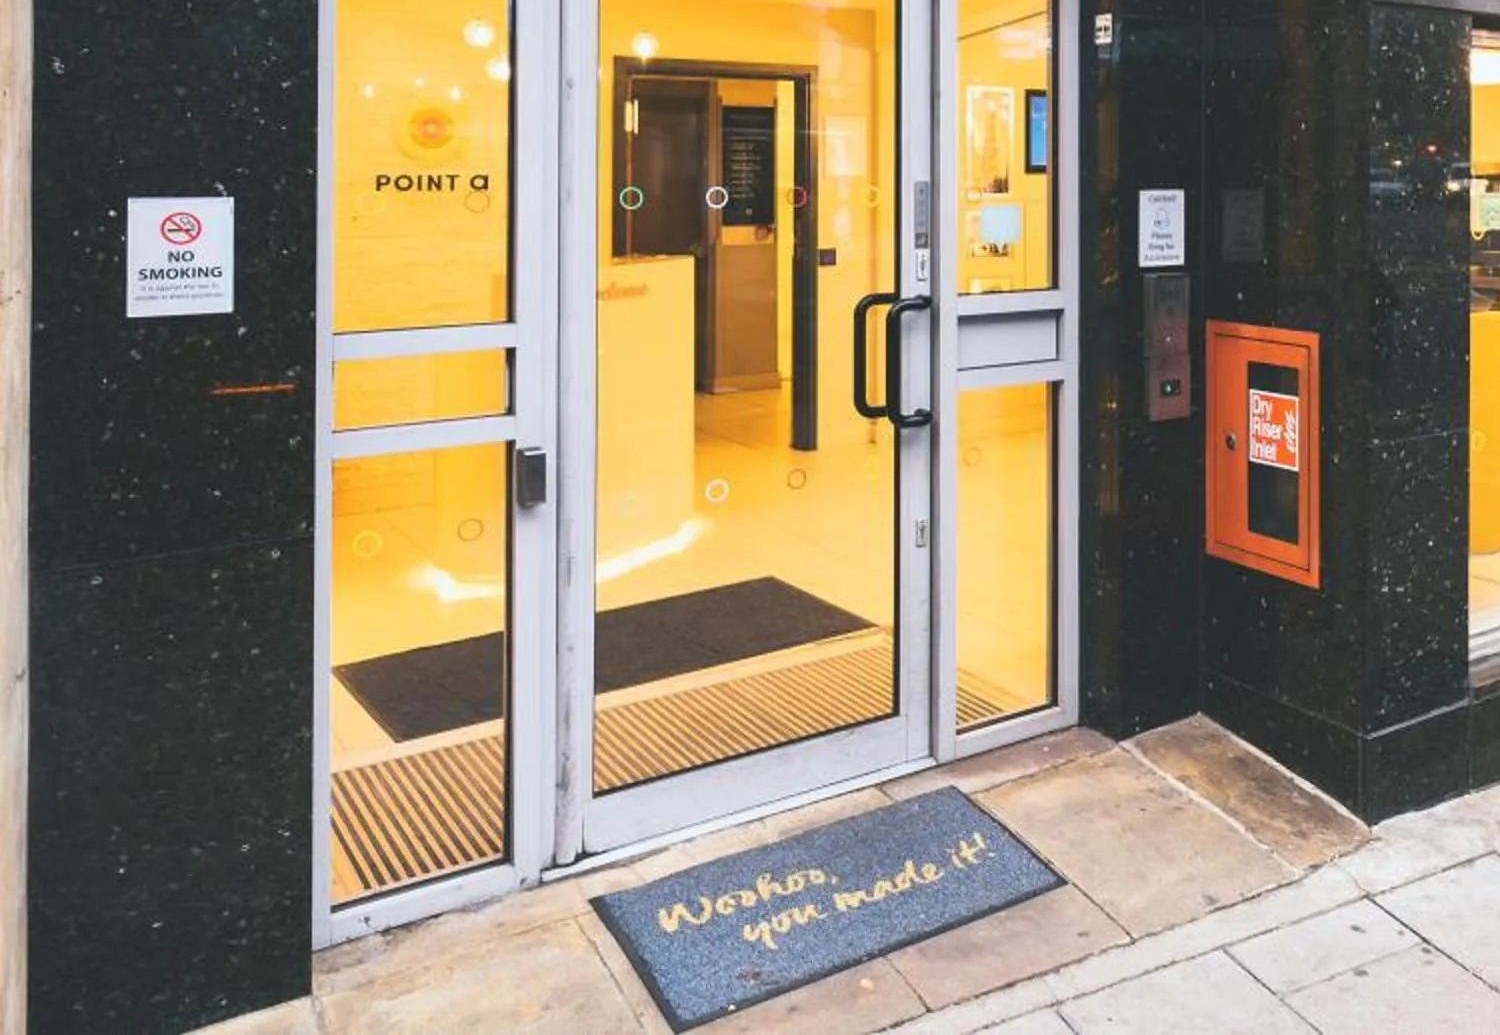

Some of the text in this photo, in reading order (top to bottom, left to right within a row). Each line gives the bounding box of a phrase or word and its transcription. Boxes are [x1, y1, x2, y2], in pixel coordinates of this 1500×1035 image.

[375, 173, 460, 192] POINT
[167, 250, 195, 263] NO
[138, 266, 223, 281] SMOKING
[1252, 395, 1273, 421] Dry
[1252, 415, 1283, 440] Riser
[1251, 437, 1277, 461] Inlet
[743, 904, 829, 950] you
[832, 860, 945, 911] made
